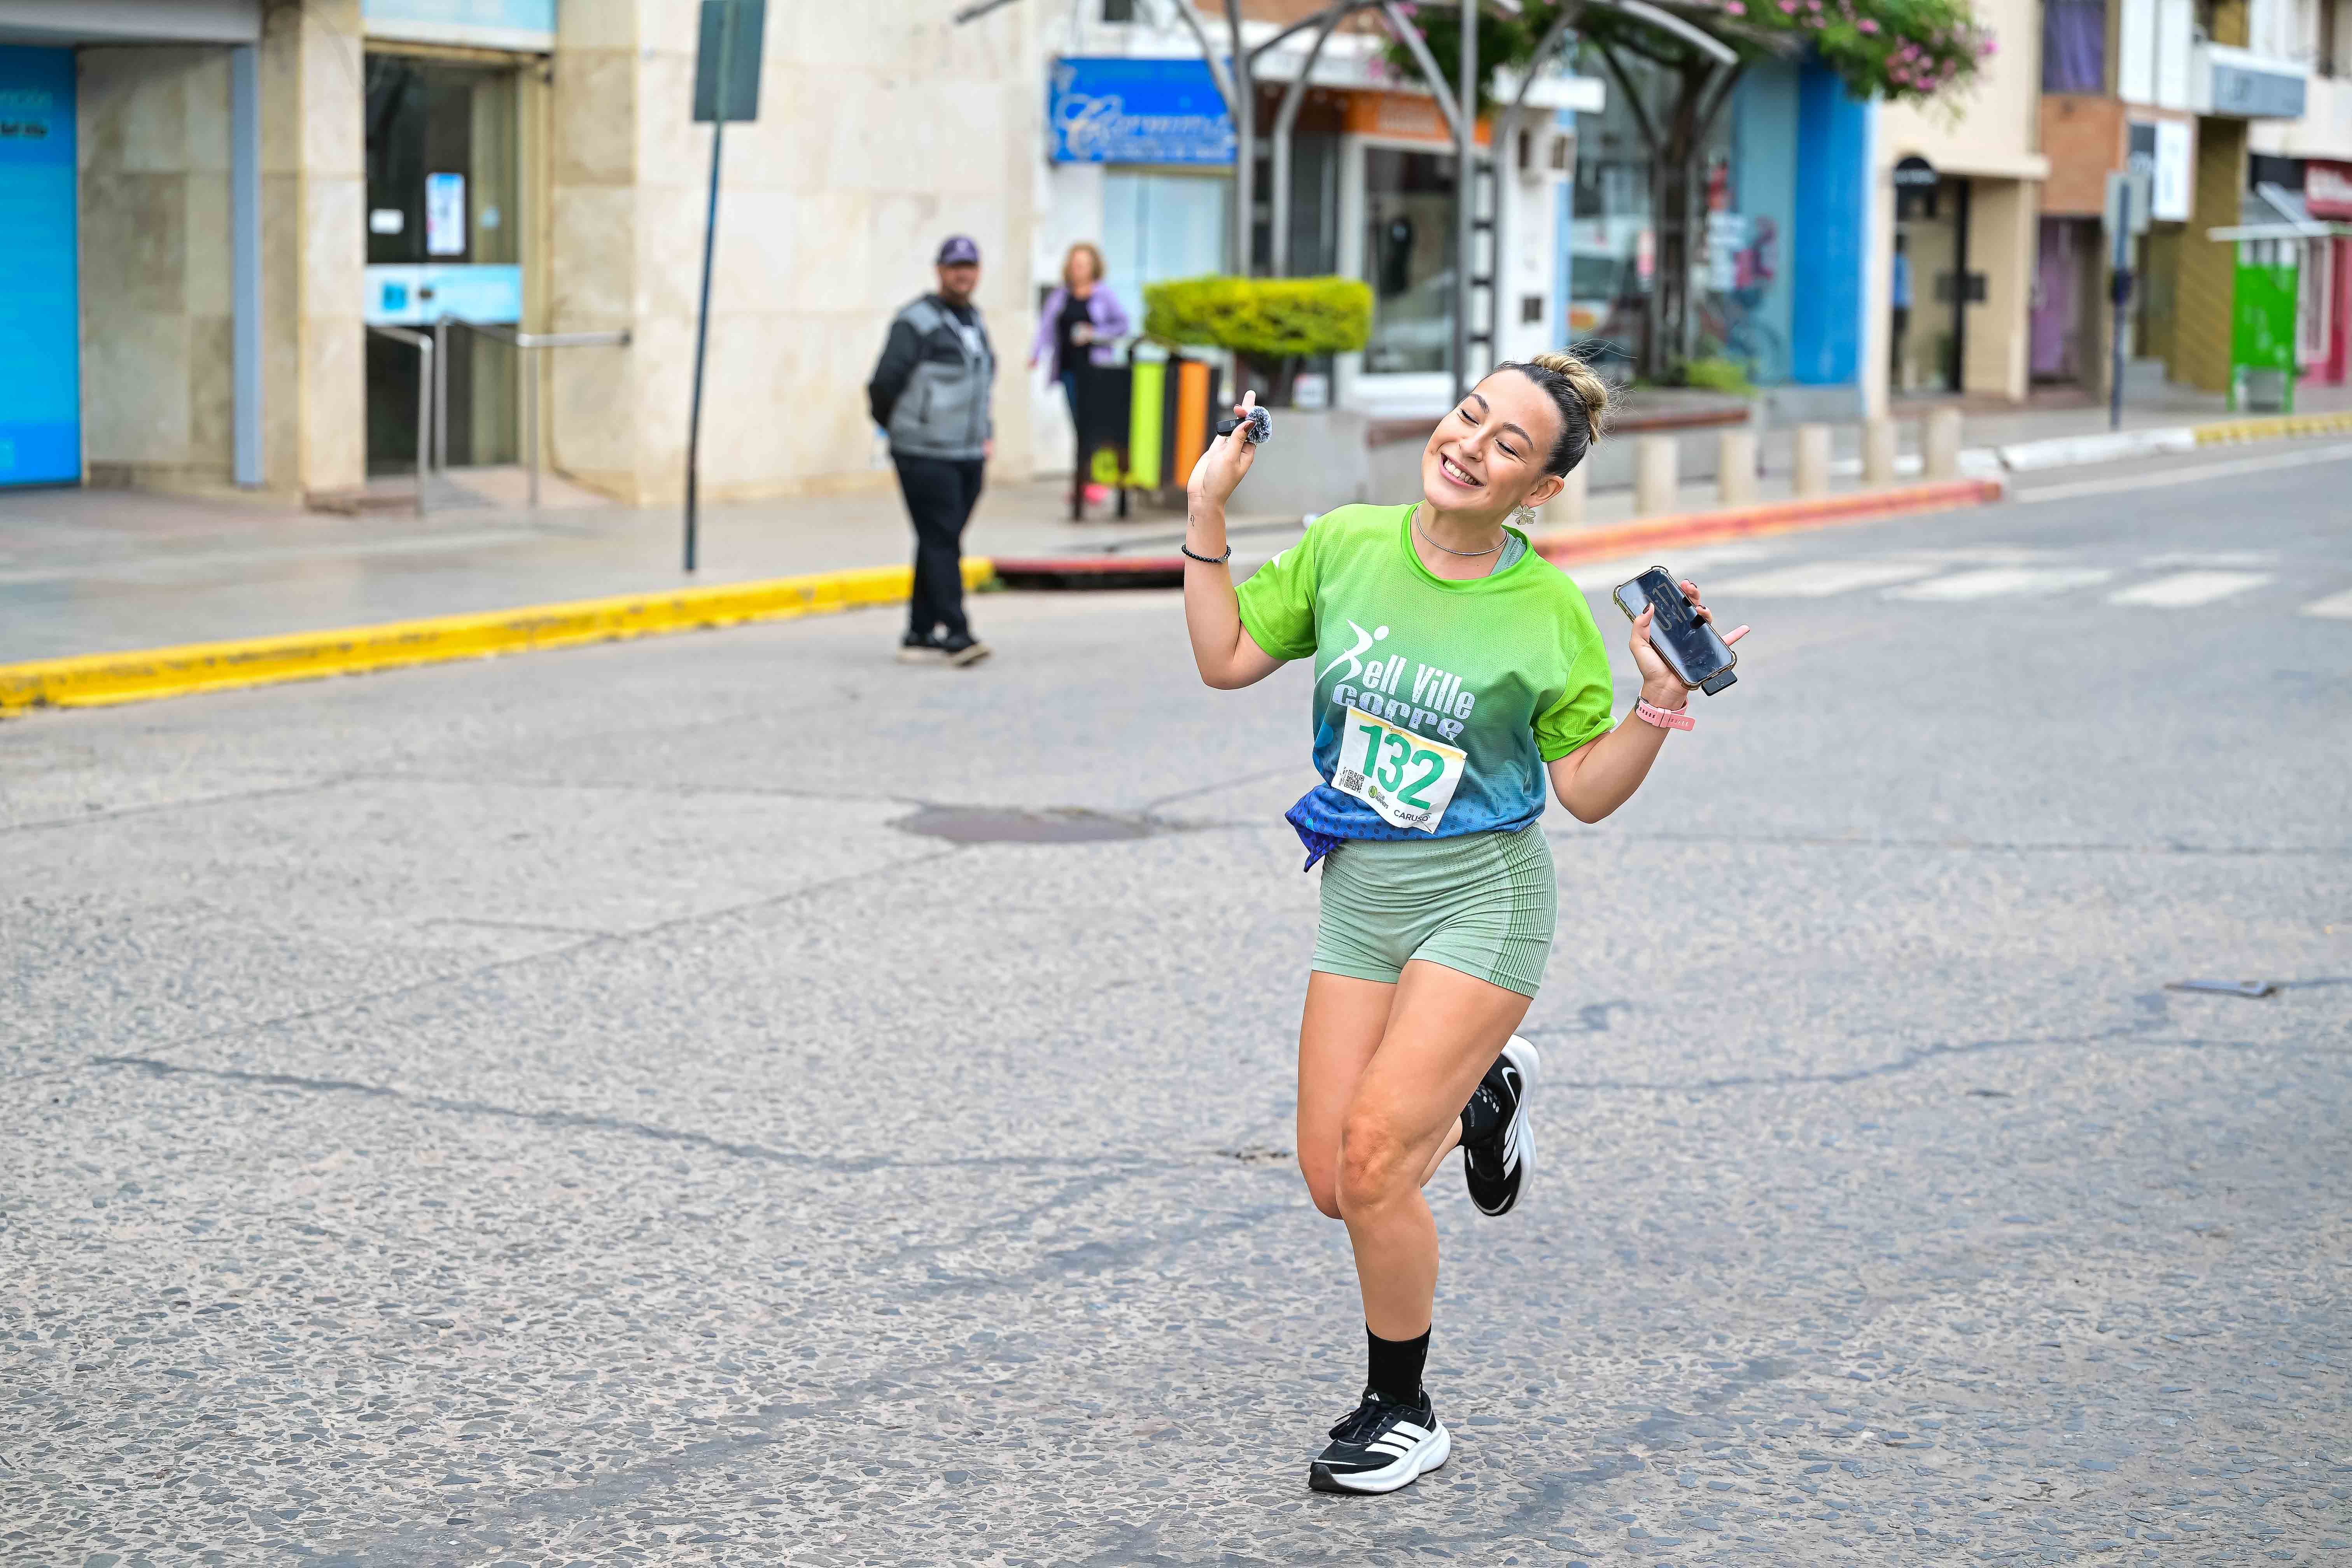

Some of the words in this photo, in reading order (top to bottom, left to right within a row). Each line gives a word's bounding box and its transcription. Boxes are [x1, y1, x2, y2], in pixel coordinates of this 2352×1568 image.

[1411, 663, 1475, 720] Ville
[1359, 725, 1445, 810] 132
[1394, 810, 1428, 822] CARUSO
